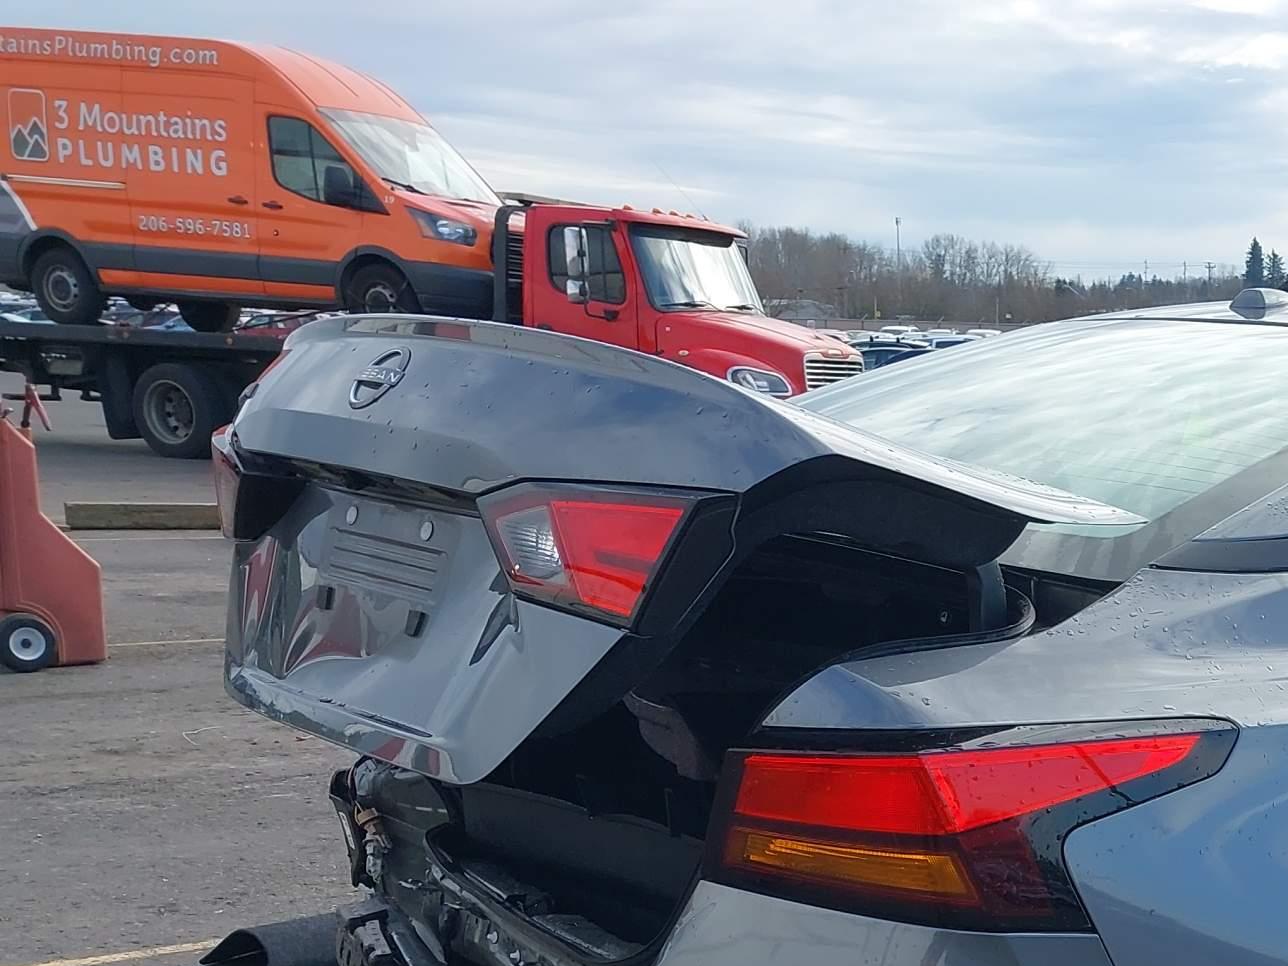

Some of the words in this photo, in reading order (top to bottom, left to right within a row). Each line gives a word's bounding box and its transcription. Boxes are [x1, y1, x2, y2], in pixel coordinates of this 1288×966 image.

[54, 100, 69, 129] 3
[78, 102, 227, 142] Mountains
[56, 137, 228, 176] PLUMBING
[138, 215, 251, 239] 206-596-7581
